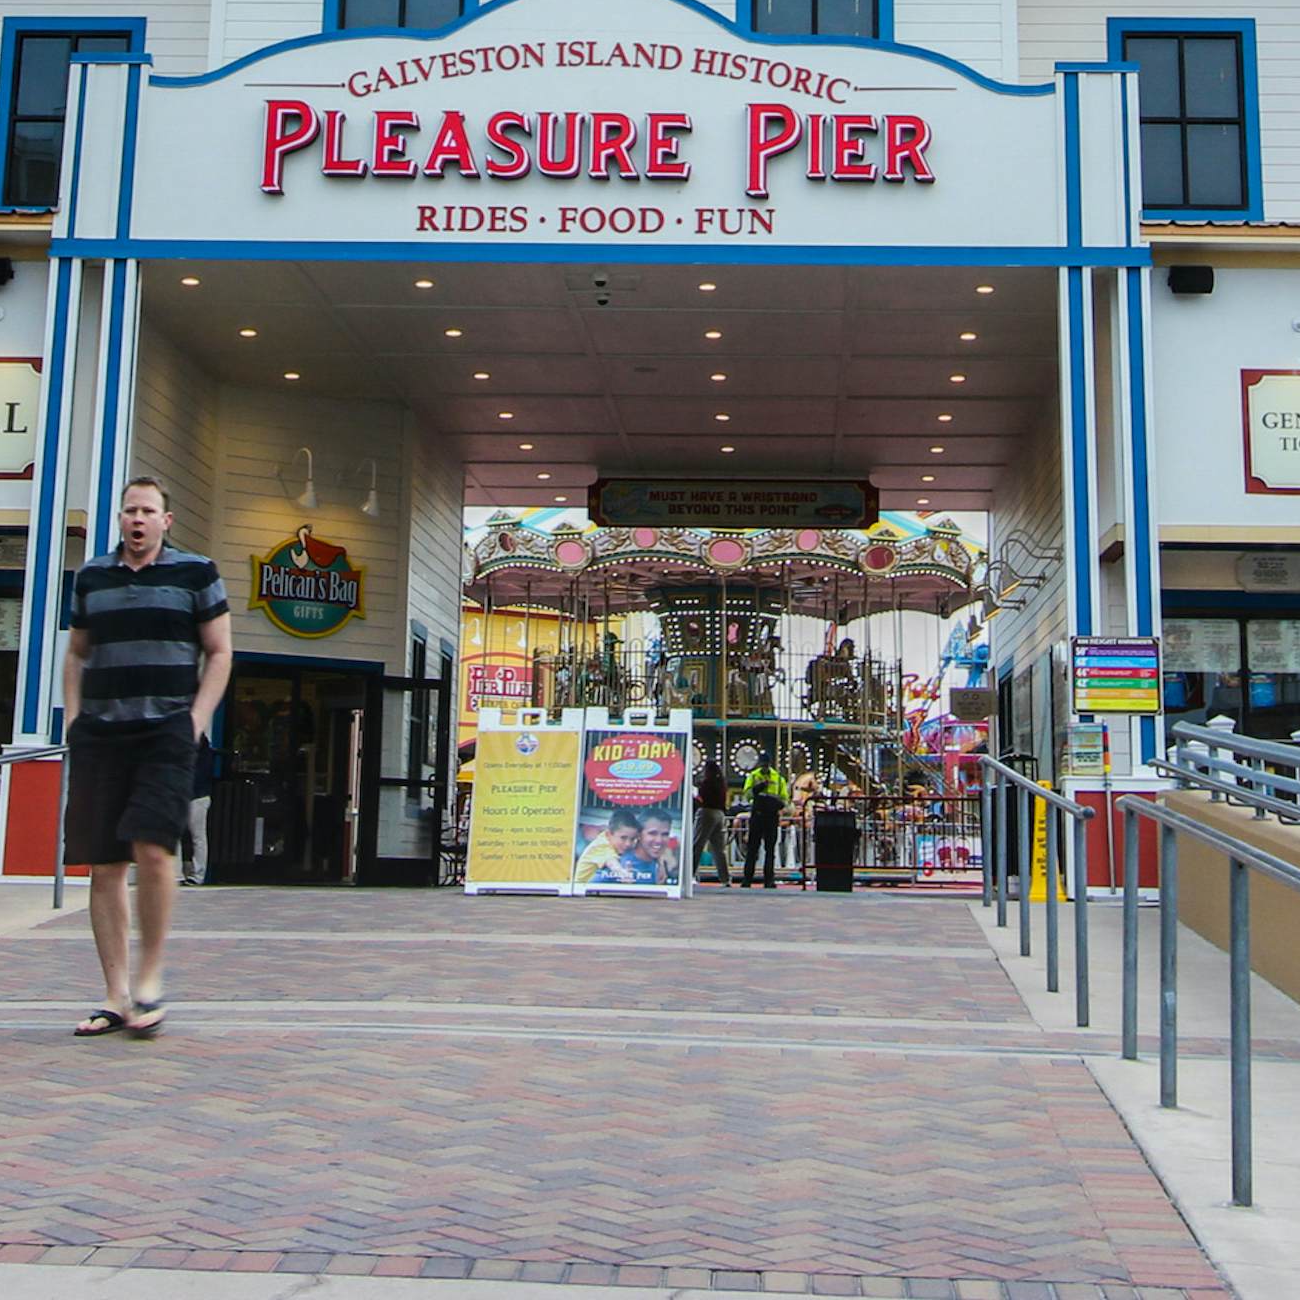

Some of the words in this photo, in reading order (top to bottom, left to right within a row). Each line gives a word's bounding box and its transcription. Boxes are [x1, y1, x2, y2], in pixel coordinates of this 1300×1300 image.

[346, 42, 547, 98] GALVESTON
[556, 41, 683, 71] ISLAND
[693, 47, 852, 105] HISTORIC
[258, 98, 694, 197] PLEASURE
[743, 102, 937, 200] PIER
[415, 205, 529, 234] RIDES
[557, 206, 666, 235] FOOD
[694, 207, 776, 236] FUN
[648, 490, 686, 502] MUST
[690, 491, 725, 502] HAVE
[741, 491, 818, 503] WRISTBAND
[667, 504, 721, 515] BEYOND
[724, 504, 755, 515] THIS
[760, 505, 800, 516] POINT
[261, 564, 327, 600] Pelican's
[329, 570, 358, 608] Bag
[293, 605, 325, 620] GIFTS
[593, 744, 624, 761] KID
[638, 742, 676, 758] DAY!
[491, 784, 533, 794] PLEASURE
[539, 784, 557, 794] PIER
[483, 805, 508, 815] Hours
[510, 805, 520, 815] of
[522, 805, 565, 817] Operation
